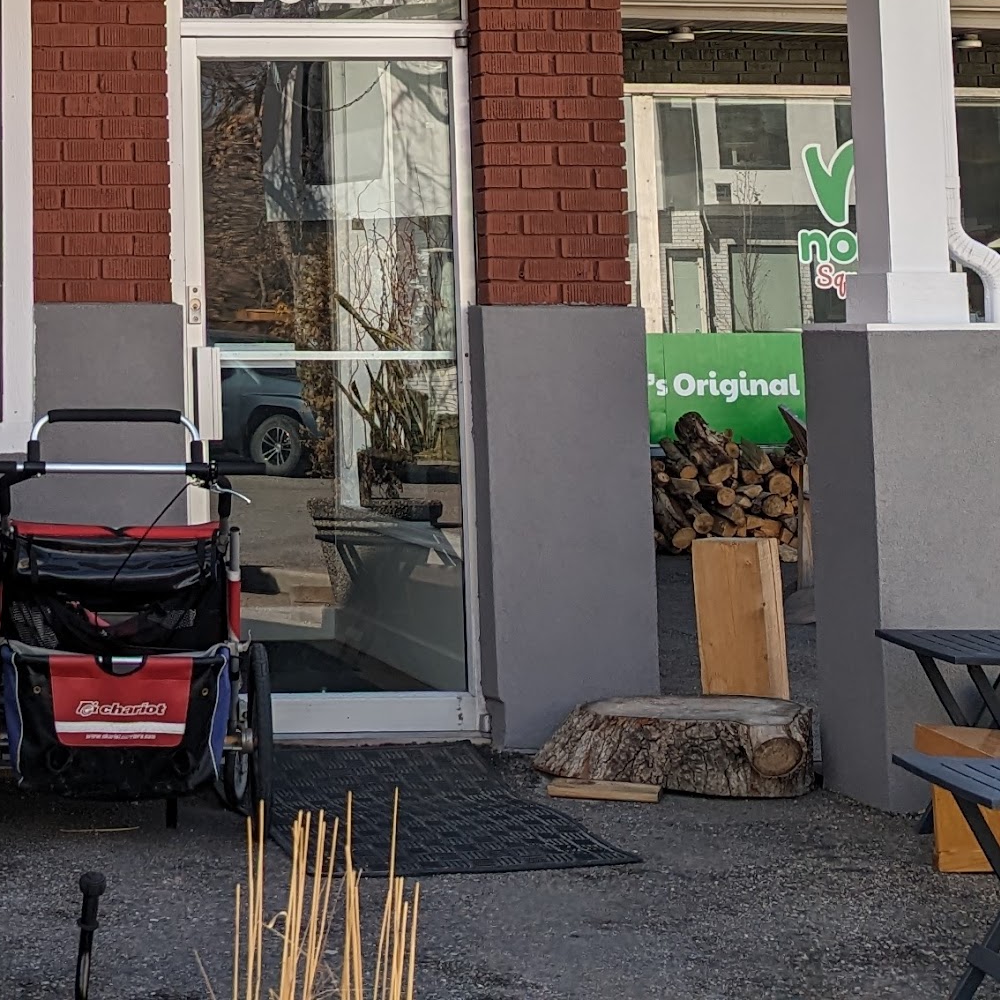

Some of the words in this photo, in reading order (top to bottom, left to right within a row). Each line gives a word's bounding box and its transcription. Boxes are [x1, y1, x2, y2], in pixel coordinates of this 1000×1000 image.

[798, 229, 859, 265] no
[815, 262, 847, 300] Sq
[647, 373, 668, 397] 's
[673, 370, 801, 403] Original
[99, 702, 167, 716] chariot
